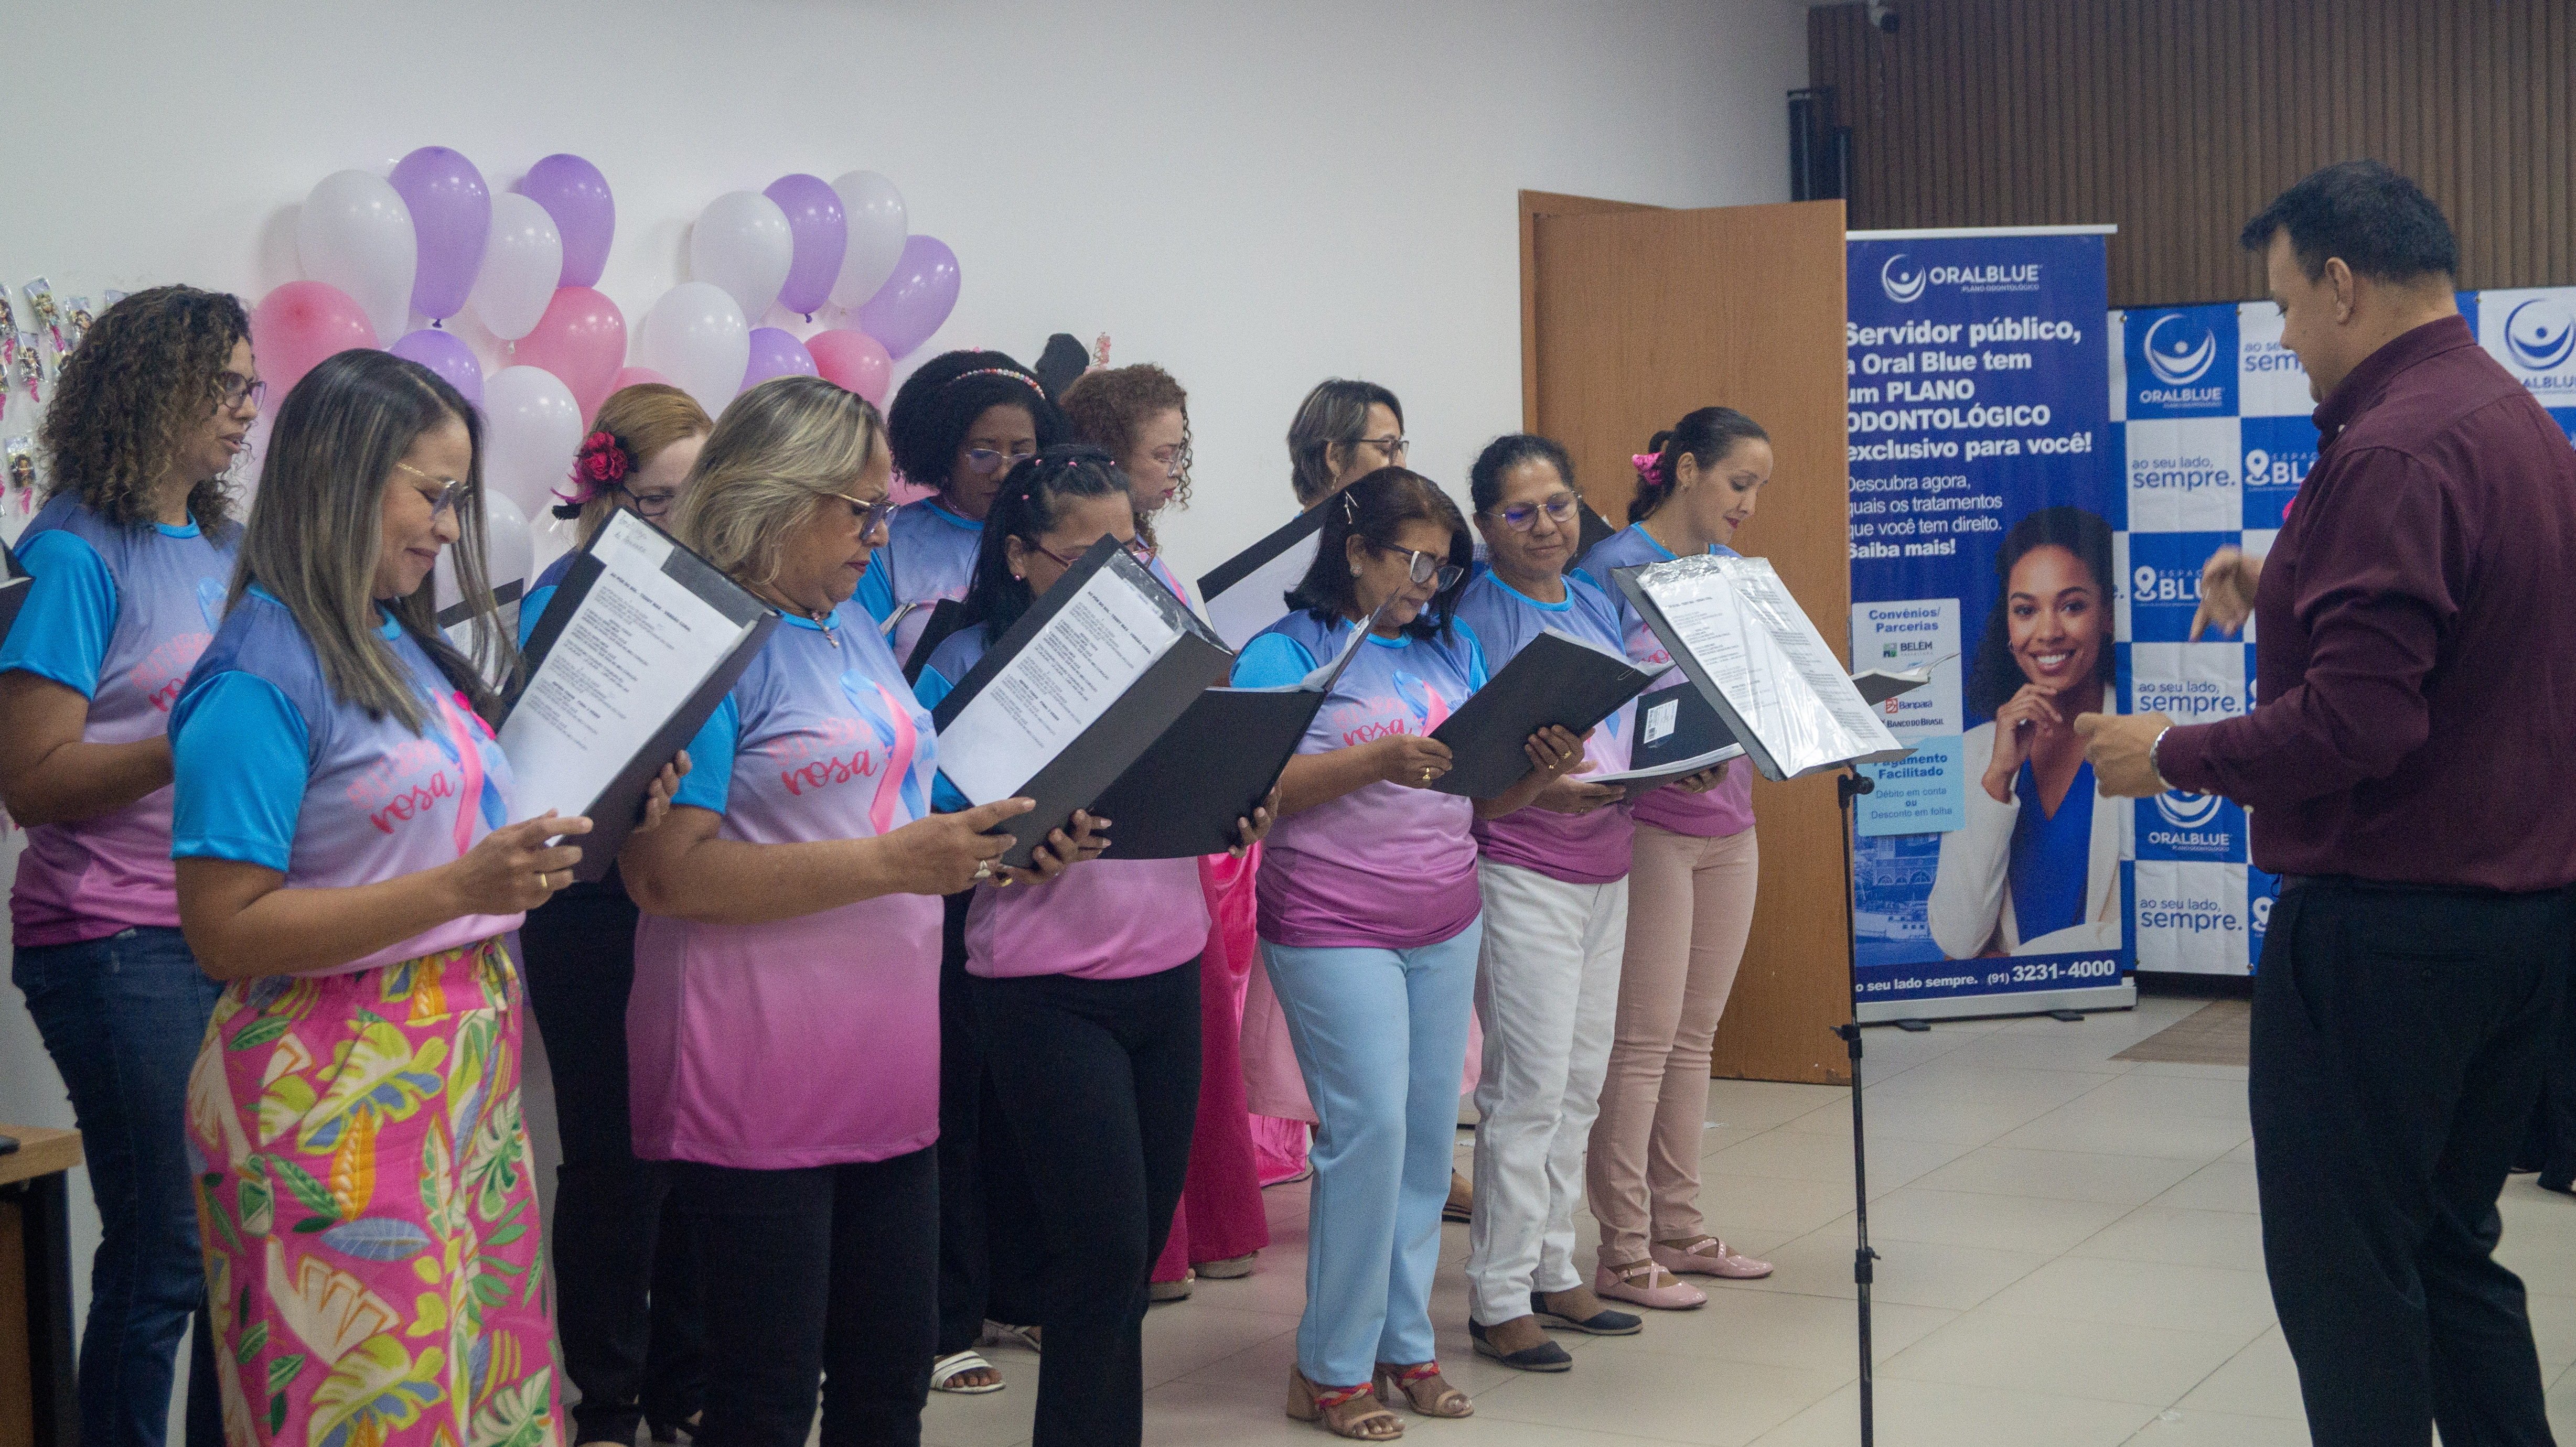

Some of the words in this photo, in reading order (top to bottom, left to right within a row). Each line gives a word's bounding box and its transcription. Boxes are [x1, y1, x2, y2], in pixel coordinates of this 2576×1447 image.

[1929, 265, 2039, 285] ORALBLUE
[1847, 320, 1962, 346] Servidor
[1969, 316, 2081, 348] público,
[1862, 352, 1915, 374] Oral
[1922, 351, 1977, 373] Blue
[1983, 349, 2032, 371] tem
[1887, 378, 1975, 403] PLANO
[2139, 387, 2222, 403] ORALBLUE
[1848, 402, 2051, 433] ODONTOLÓGICO
[1849, 438, 1958, 461] exclusivo
[1965, 438, 2020, 462] para
[2026, 431, 2092, 455] você!
[2132, 460, 2149, 470] ao
[2152, 459, 2176, 469] seu
[2180, 456, 2214, 469] lado,
[1849, 474, 1918, 492] Descubra
[1922, 475, 1971, 493] agora,
[2133, 470, 2236, 492] sempre.
[1890, 499, 1909, 513] os
[1912, 494, 2003, 512] tratamentos
[1878, 518, 1915, 535] você
[1919, 519, 1948, 534] tem
[1952, 515, 2002, 532] direito.
[1850, 541, 1900, 559] Saiba
[1905, 538, 1956, 556] mais!
[1869, 607, 1941, 620] Convênios/
[1876, 621, 1939, 633] Parcerias
[2138, 683, 2155, 693] ao
[2160, 683, 2182, 692] seu
[2187, 682, 2220, 695] lado,
[1899, 699, 1933, 709] Banpará
[2140, 695, 2241, 716] sempre.
[1887, 719, 1909, 728] BANCO
[781, 749, 878, 796] rosa
[1879, 765, 1944, 779] Facilitado
[370, 770, 456, 834] rosa
[1876, 790, 1904, 798] Débito
[1923, 787, 1947, 795] conta
[1871, 809, 1912, 819] Desconto
[2148, 831, 2229, 846] ORALBLUE
[2140, 899, 2156, 909] ao
[2161, 900, 2184, 910] seu
[2188, 898, 2221, 912] lado,
[2141, 911, 2243, 933] sempre.
[1867, 982, 1891, 991] seu
[1894, 978, 1923, 989] lado
[1926, 976, 1978, 988] sempre.
[1988, 973, 2010, 985] (91)
[2012, 959, 2116, 982] 3231-4000
